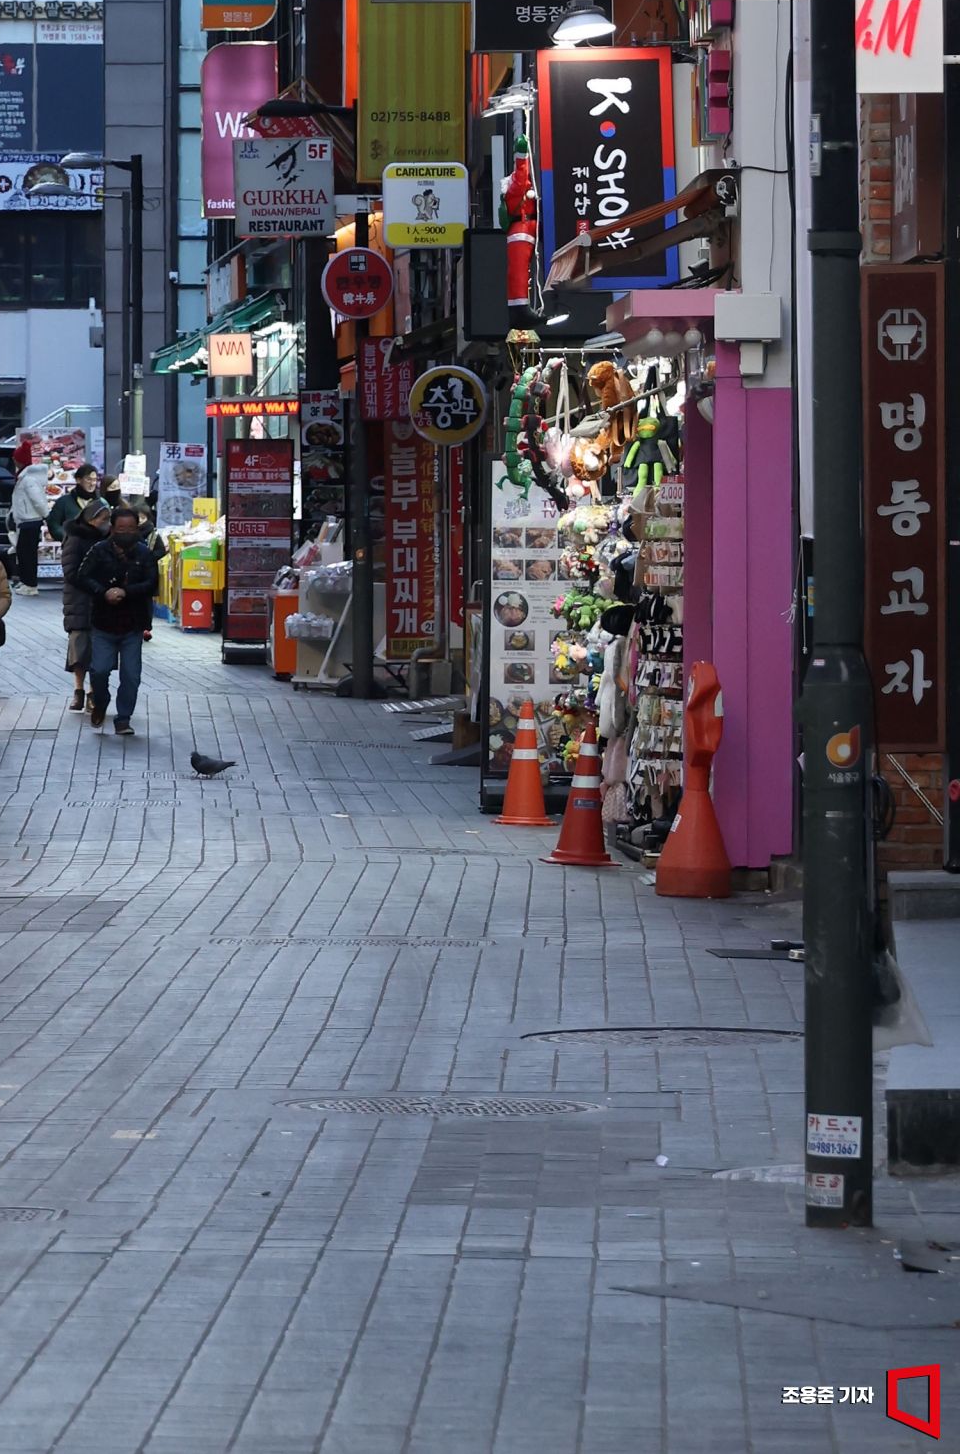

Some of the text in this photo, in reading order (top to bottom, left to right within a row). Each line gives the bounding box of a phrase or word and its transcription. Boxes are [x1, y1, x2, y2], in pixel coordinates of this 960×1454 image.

[586, 76, 633, 117] K
[307, 143, 328, 159] 5F
[395, 167, 456, 177] CARICATURE
[243, 189, 329, 207] GURKHA
[571, 166, 591, 217] 케이샵
[251, 208, 321, 217] INDIAN/NEPALI
[248, 220, 325, 232] RESTAURANT
[216, 341, 246, 356] WM
[220, 403, 240, 415] WM
[242, 403, 263, 415] WM
[265, 402, 286, 415] WM
[310, 406, 321, 416] 3F
[244, 454, 260, 467] 4F
[661, 486, 683, 500] 2,000
[228, 521, 269, 534] BUFFET
[876, 392, 933, 706] 명동교자
[808, 1116, 841, 1132] 카드
